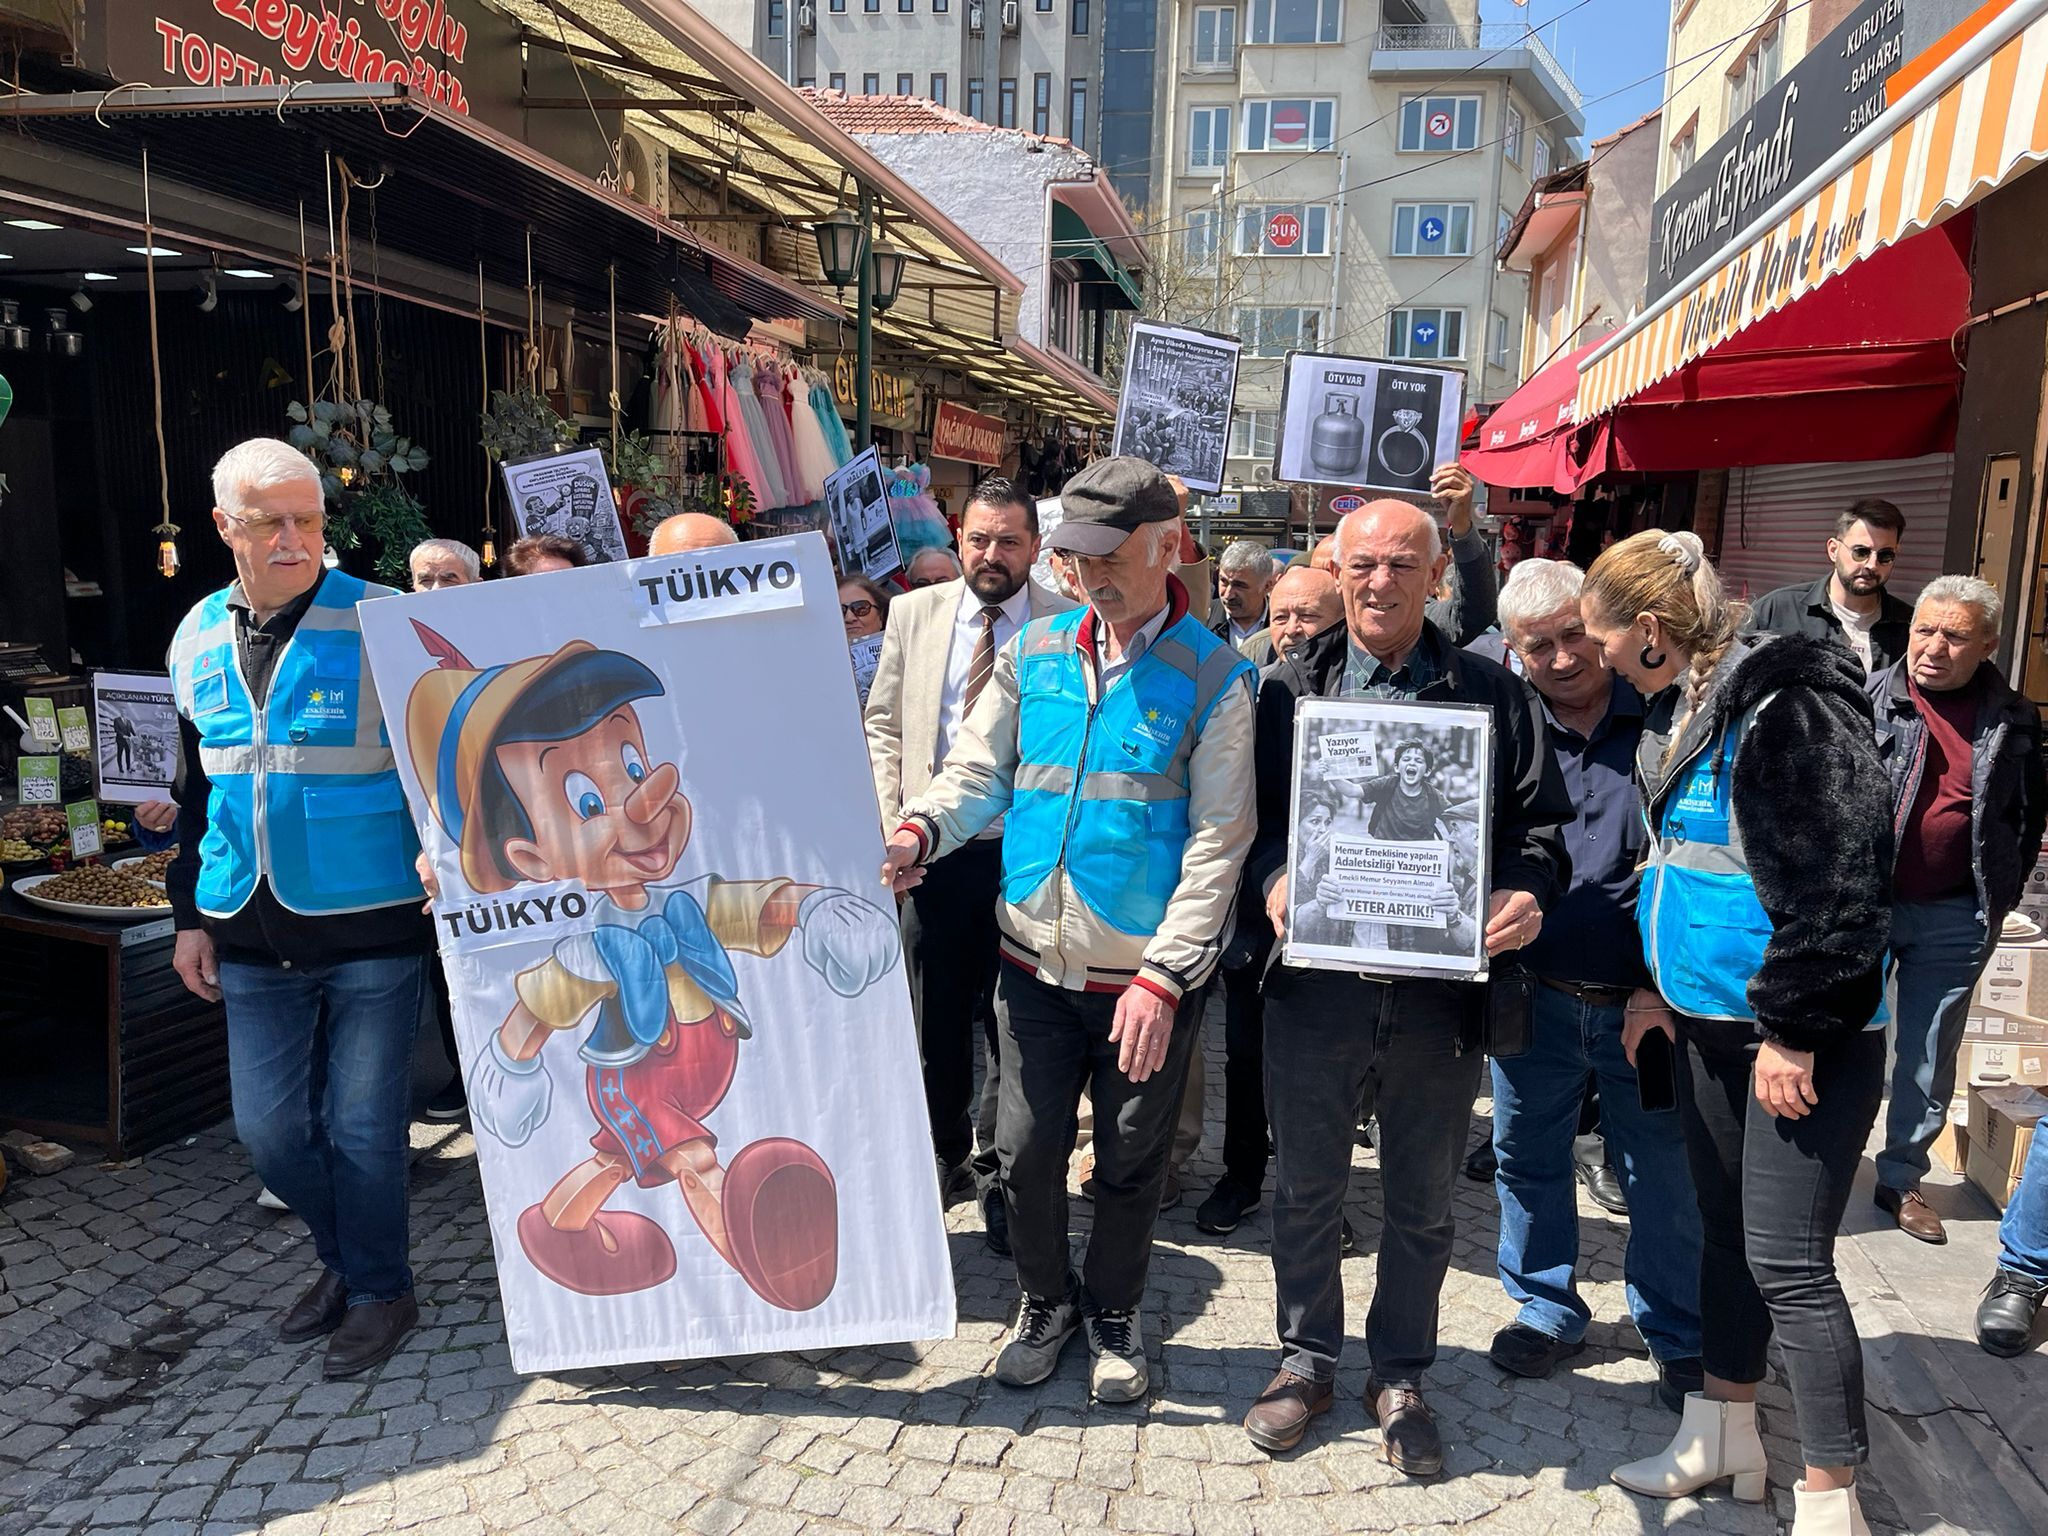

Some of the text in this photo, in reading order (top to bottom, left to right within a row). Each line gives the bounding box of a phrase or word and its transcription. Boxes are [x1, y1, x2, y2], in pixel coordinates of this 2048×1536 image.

[1658, 81, 1799, 280] Kerem Efendi
[1270, 224, 1298, 237] DUR
[1752, 222, 1818, 309] Home
[1819, 208, 1867, 270] Ekstra
[834, 353, 906, 419] GÜDEM
[1327, 371, 1363, 386] ÖTV VAR
[1391, 377, 1427, 393] ÖTV YOK
[638, 560, 796, 606] TÜİKYO
[151, 694, 169, 703] TÜİK
[1326, 738, 1359, 748] Yazıyor
[1334, 845, 1438, 862] Memur Emeklisine yapılan
[1335, 856, 1395, 872] Adaletsizliği
[1360, 875, 1382, 883] Memur
[441, 892, 587, 938] TÜİKYO
[1346, 899, 1435, 918] YETER ARTIK!!
